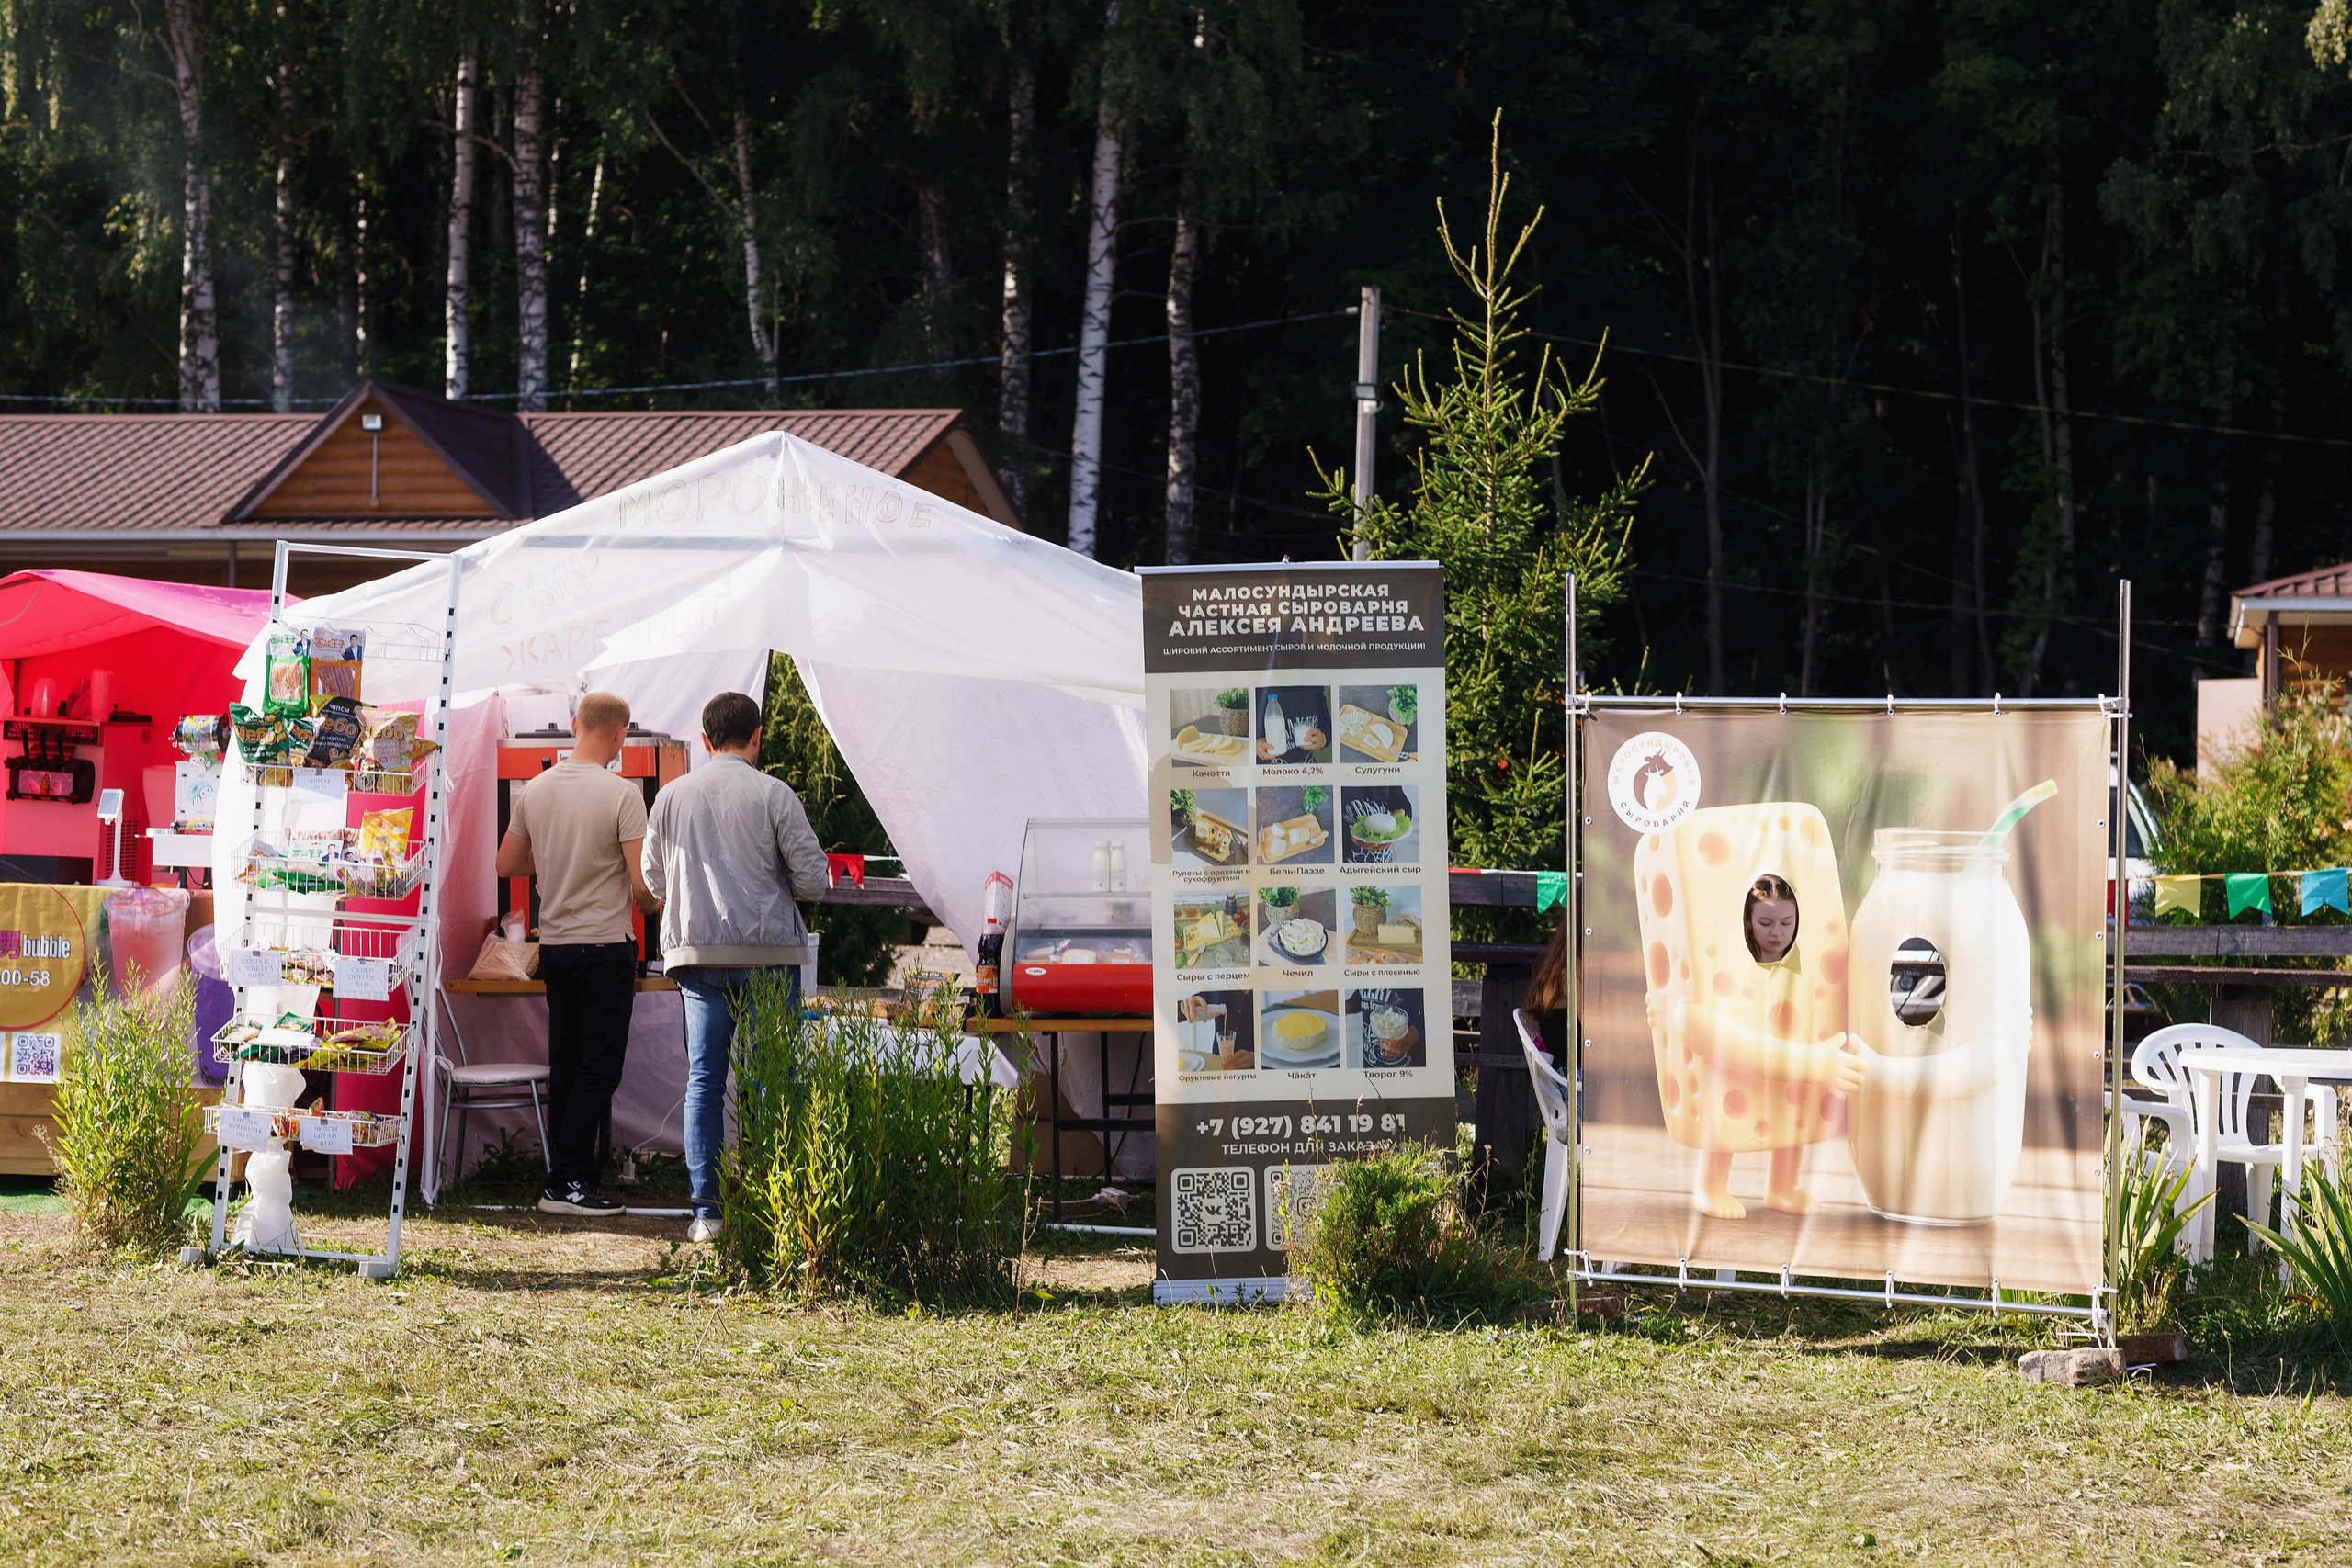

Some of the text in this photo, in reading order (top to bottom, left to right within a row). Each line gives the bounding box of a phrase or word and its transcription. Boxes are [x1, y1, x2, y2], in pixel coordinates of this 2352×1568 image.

[618, 472, 934, 528] МОРОЖЕНОЕ
[490, 550, 600, 630] СЫР
[1193, 583, 1389, 601] МАЛОСУНДЫРСКАЯ
[1178, 600, 1408, 618] ЧАСТНАЯ СЫРОВАРНЯ
[1169, 615, 1424, 637] АЛЕКСЕЯ АНДРЕЕВА
[1163, 646, 1208, 655] ШИРОКИЙ
[1210, 644, 1273, 654] АССОРТИМЕНТ
[1275, 643, 1306, 651] СЫРОВ
[1316, 642, 1366, 651] МОЛОЧНОЙ
[1369, 642, 1426, 651] ПРОДУКЦИИ!
[322, 718, 358, 737] ебо
[1613, 739, 1696, 785] МАЛОСУНДЫРСКАЯ
[1301, 766, 1324, 775] 4,2%
[1355, 766, 1401, 775] Сулугуни
[1620, 800, 1690, 828] СЫРОВАРНЯ
[1172, 870, 1202, 878] Рулеты
[1210, 869, 1244, 877] орехами
[1269, 867, 1325, 875] Бель-Паэзе
[1339, 865, 1421, 874] Адыгейский сыр
[1183, 875, 1240, 884] сухофруктами
[22, 933, 71, 959] bubble
[1176, 974, 1204, 982] Сыры
[1215, 973, 1250, 981] перцем
[1344, 969, 1369, 977] Сыры
[1178, 1075, 1222, 1083] Фруктовые
[1363, 1069, 1413, 1078] Творог 9%
[1196, 1113, 1406, 1140] +7 (927) 841 19 81
[1221, 1142, 1290, 1155] ТЕЛЕФОН
